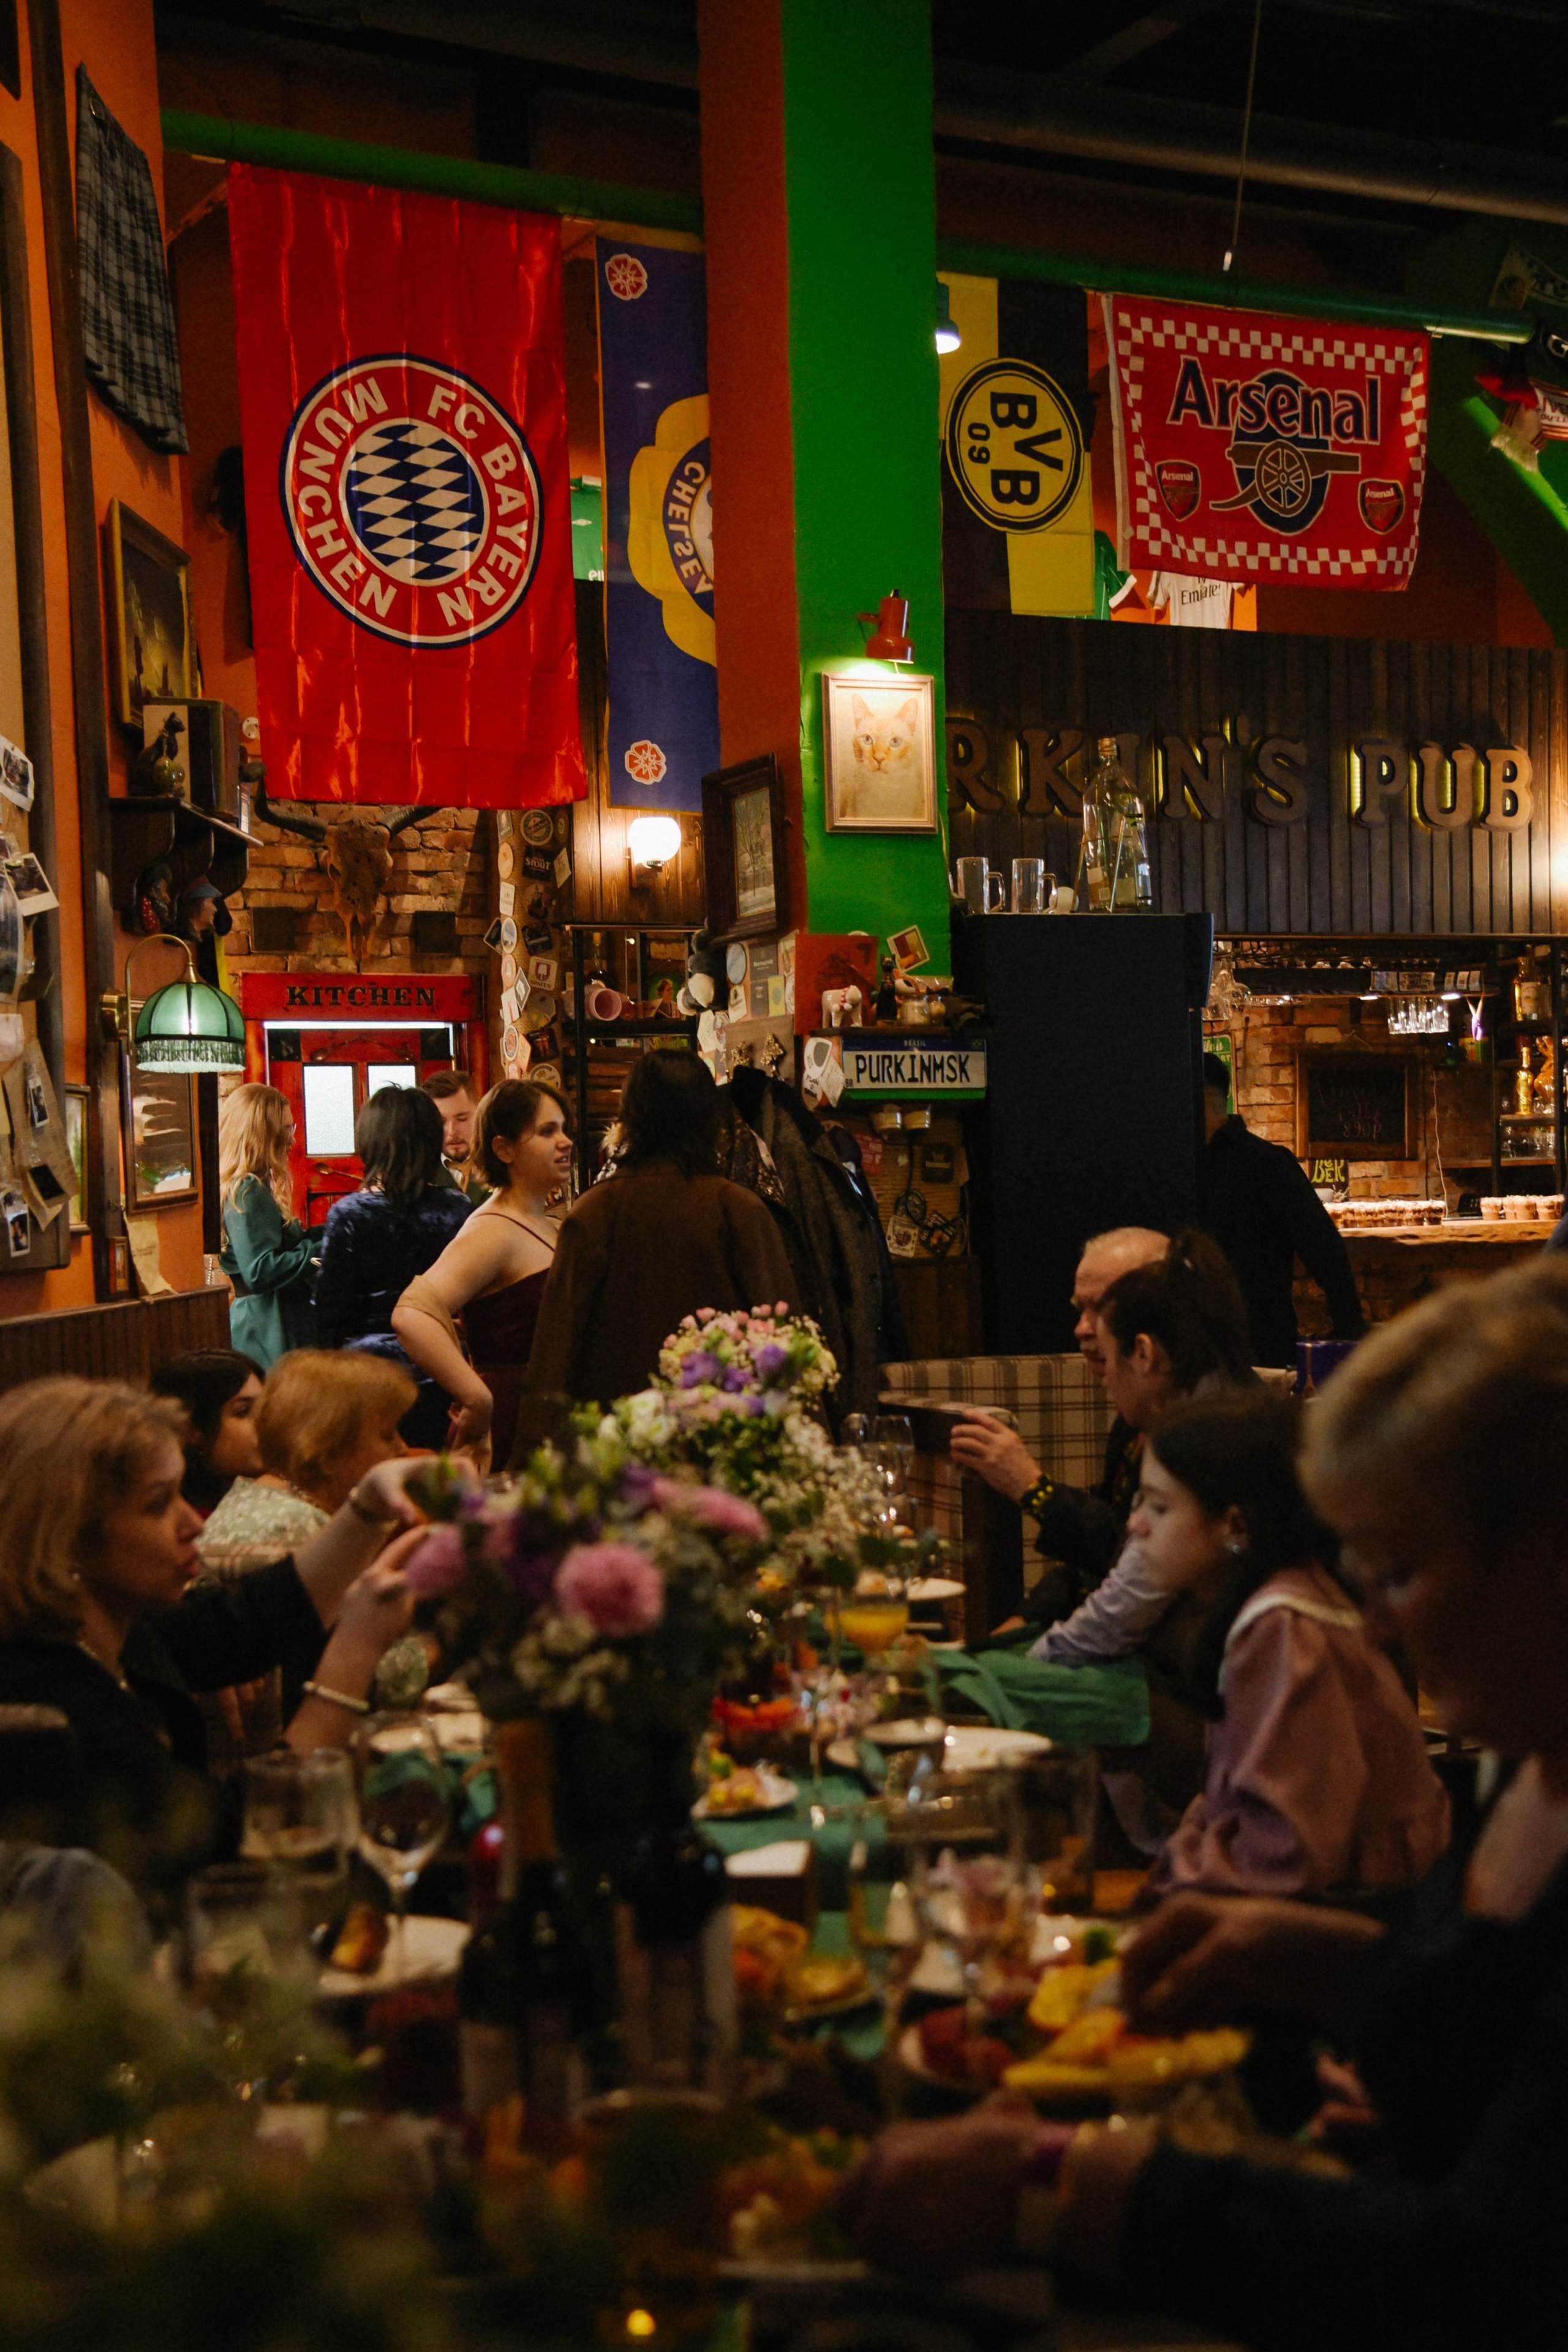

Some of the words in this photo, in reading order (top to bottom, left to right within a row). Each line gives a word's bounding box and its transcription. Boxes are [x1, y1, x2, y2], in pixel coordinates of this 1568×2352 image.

[427, 384, 485, 439] FC
[1166, 355, 1381, 445] Arsenal
[967, 422, 990, 464] 09
[990, 391, 1063, 506] BVB
[1161, 470, 1194, 482] Arsenal
[1365, 487, 1395, 499] Arsenal
[437, 442, 529, 627] BAYERN
[1357, 742, 1532, 831] PUB
[525, 857, 551, 870] STOUT
[286, 986, 435, 1006] KITCHEN
[845, 1079, 853, 1087] BR
[856, 1054, 970, 1083] PURKINMSK
